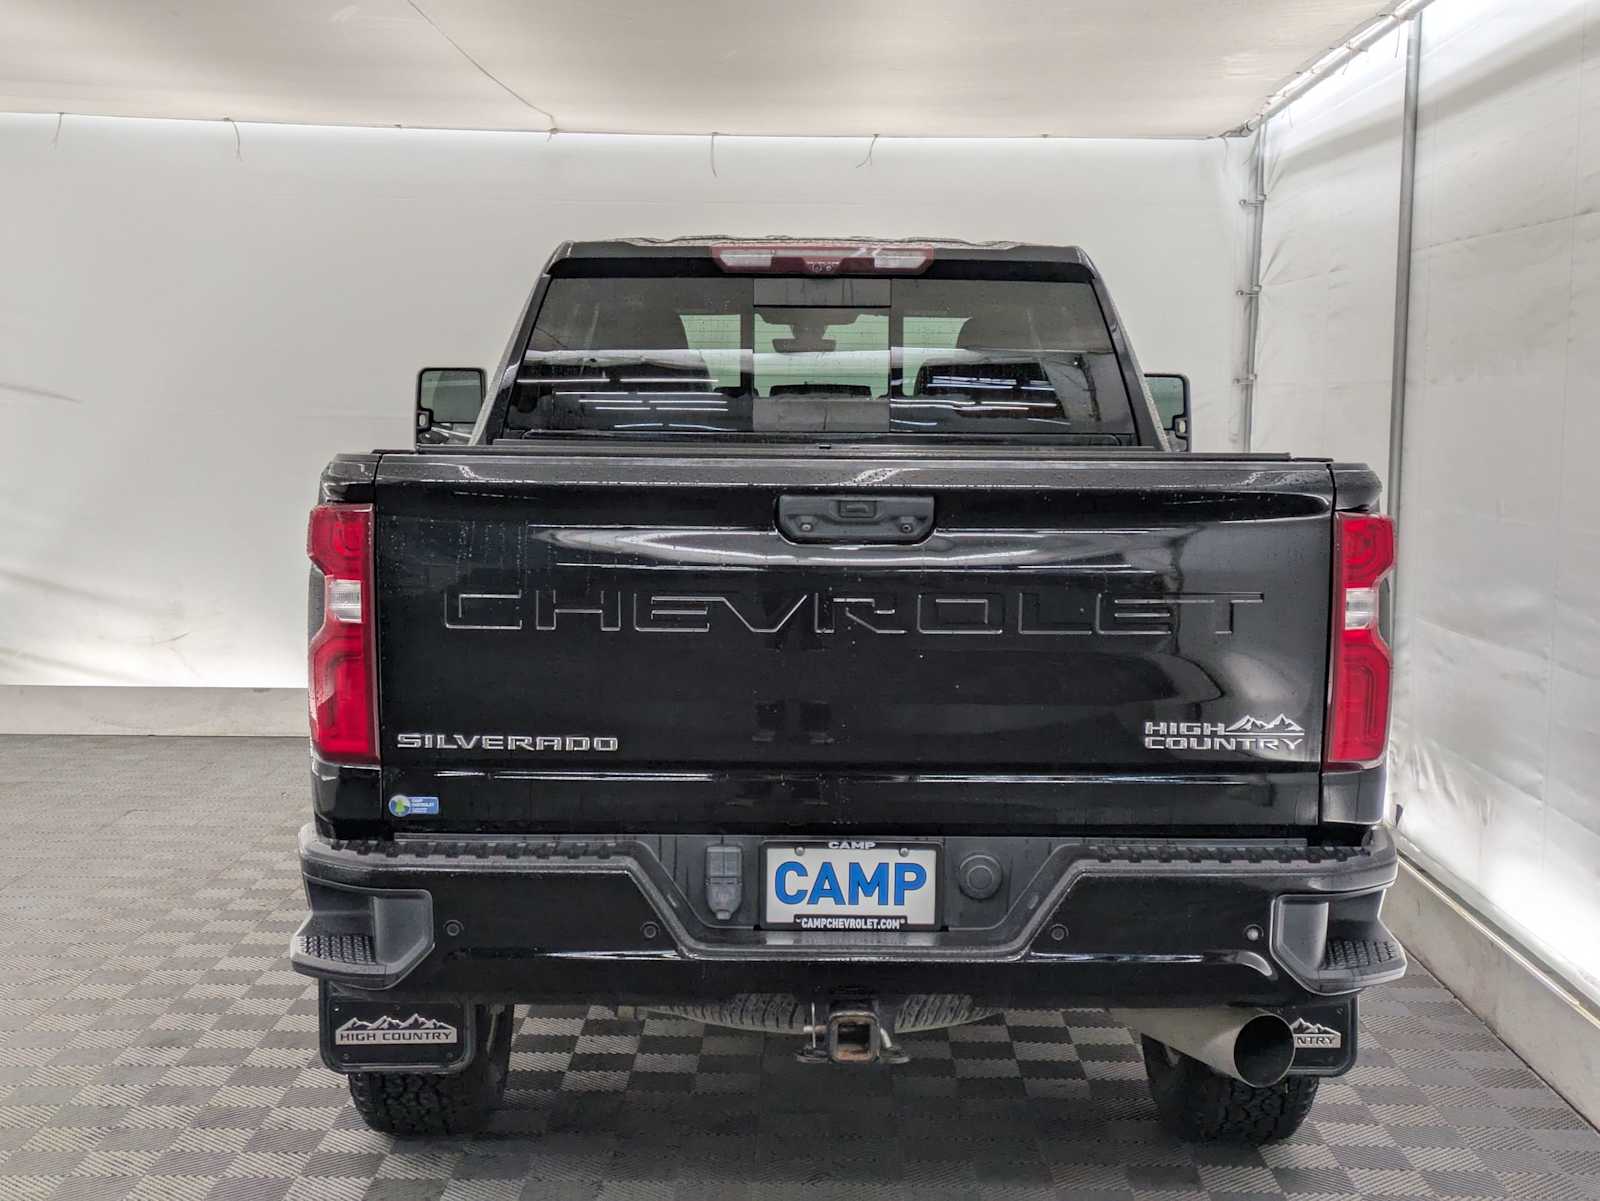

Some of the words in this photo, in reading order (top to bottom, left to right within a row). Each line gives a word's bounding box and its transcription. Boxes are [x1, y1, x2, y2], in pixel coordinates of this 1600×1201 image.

[443, 589, 1265, 636] CHEVROLET
[1144, 721, 1226, 736] HIGH
[397, 733, 619, 751] SILVERADO
[1144, 736, 1303, 751] COUNTRY
[828, 841, 876, 850] CAMP
[774, 860, 927, 906] CAMP
[801, 917, 900, 930] CAMPCHEVROLET.COM
[340, 1033, 376, 1042] HIGH
[382, 1032, 451, 1041] COUNTRY
[1296, 1036, 1336, 1045] NTRY
